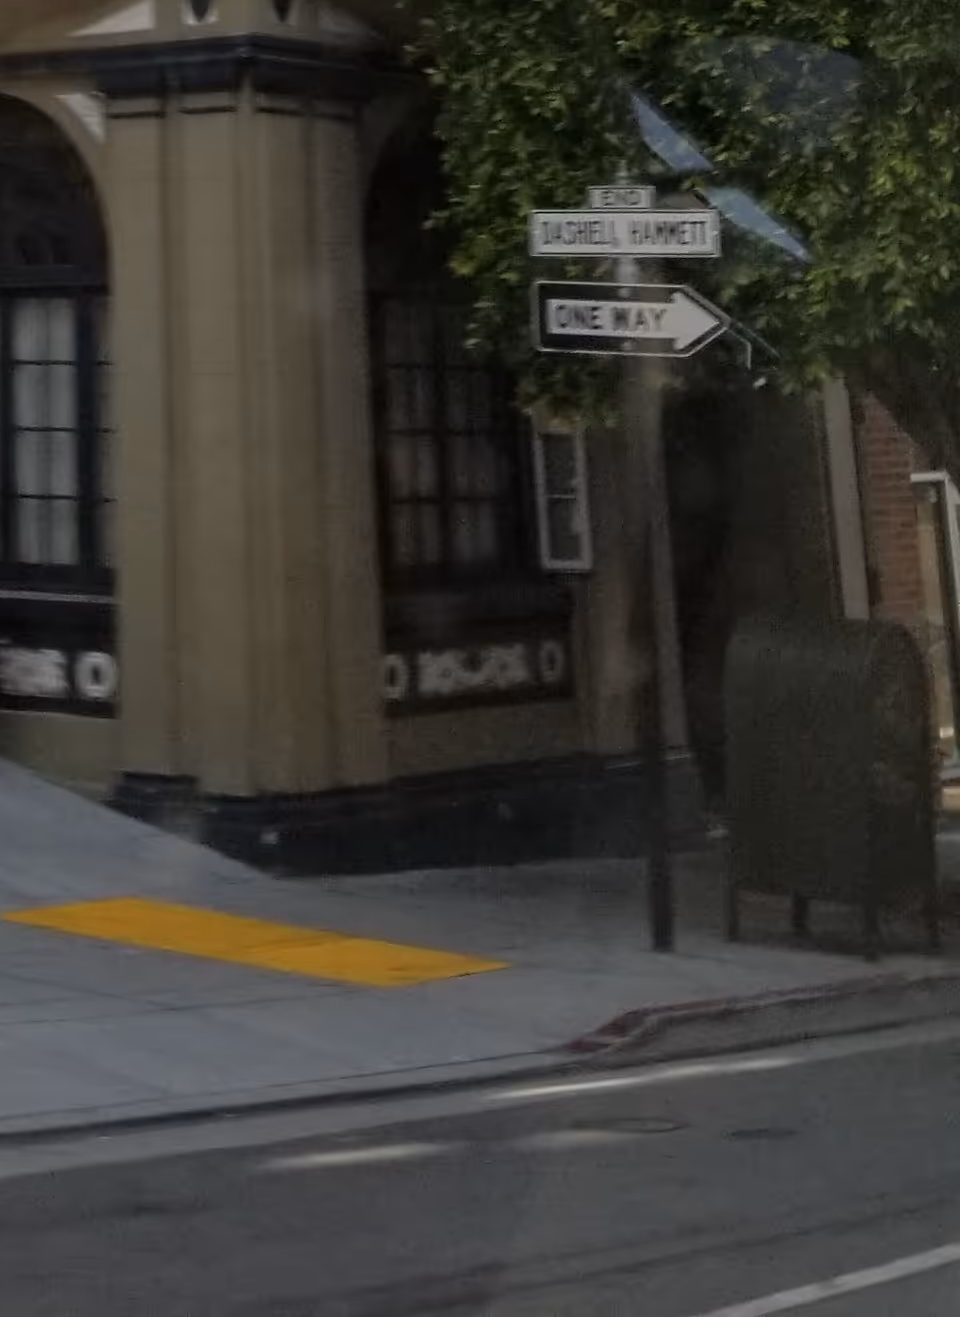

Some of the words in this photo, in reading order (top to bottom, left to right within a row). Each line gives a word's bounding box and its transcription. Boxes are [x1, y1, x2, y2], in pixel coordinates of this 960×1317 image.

[601, 190, 642, 206] END
[630, 220, 707, 245] HAMMETT
[555, 305, 603, 330] ONE
[612, 307, 667, 332] WAY
